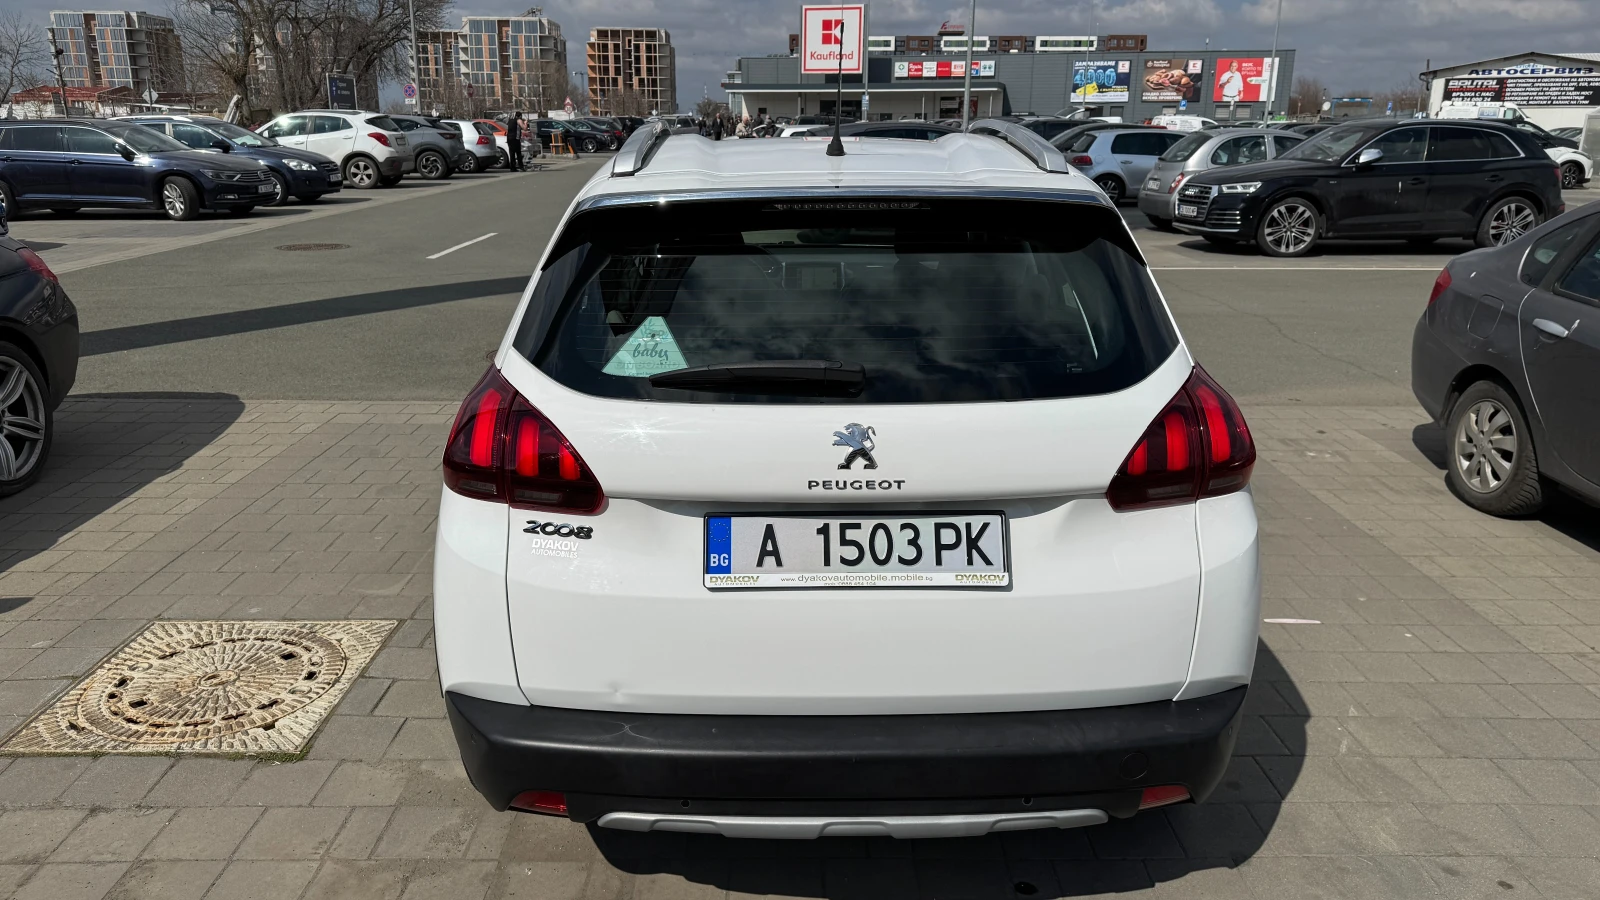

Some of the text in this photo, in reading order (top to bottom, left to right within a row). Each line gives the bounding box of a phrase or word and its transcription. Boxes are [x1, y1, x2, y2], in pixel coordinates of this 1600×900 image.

[810, 51, 854, 61] Kaufland
[1467, 67, 1594, 76] АВТОСЕРВИЗ
[632, 343, 669, 361] baby
[807, 480, 906, 490] PEUGEOT
[523, 519, 594, 540] 2008
[531, 538, 579, 551] DYAKOV
[756, 523, 783, 567] A
[530, 549, 578, 558] AUTOMOBILES
[709, 553, 729, 567] BG
[709, 575, 760, 583] DYAKOV
